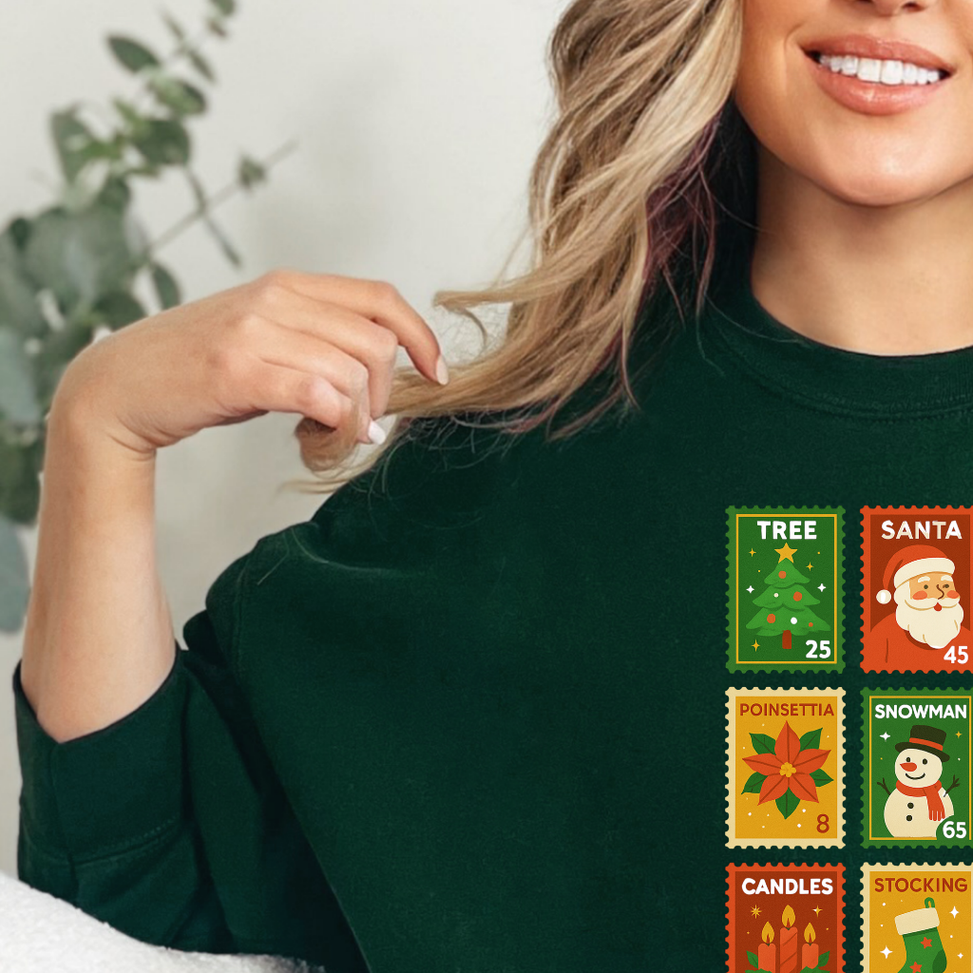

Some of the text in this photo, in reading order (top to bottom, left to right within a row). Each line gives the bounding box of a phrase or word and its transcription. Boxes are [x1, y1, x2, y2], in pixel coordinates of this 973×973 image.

[757, 521, 817, 540] TREE
[881, 521, 962, 540] SANTA
[805, 640, 831, 659] 25
[943, 646, 968, 664] 45
[740, 703, 834, 716] POINSETTIA
[875, 704, 967, 719] SNOWMAN
[816, 813, 830, 833] 8
[942, 821, 967, 839] 65
[742, 878, 833, 895] CANDLES
[874, 878, 968, 892] STOCKING
